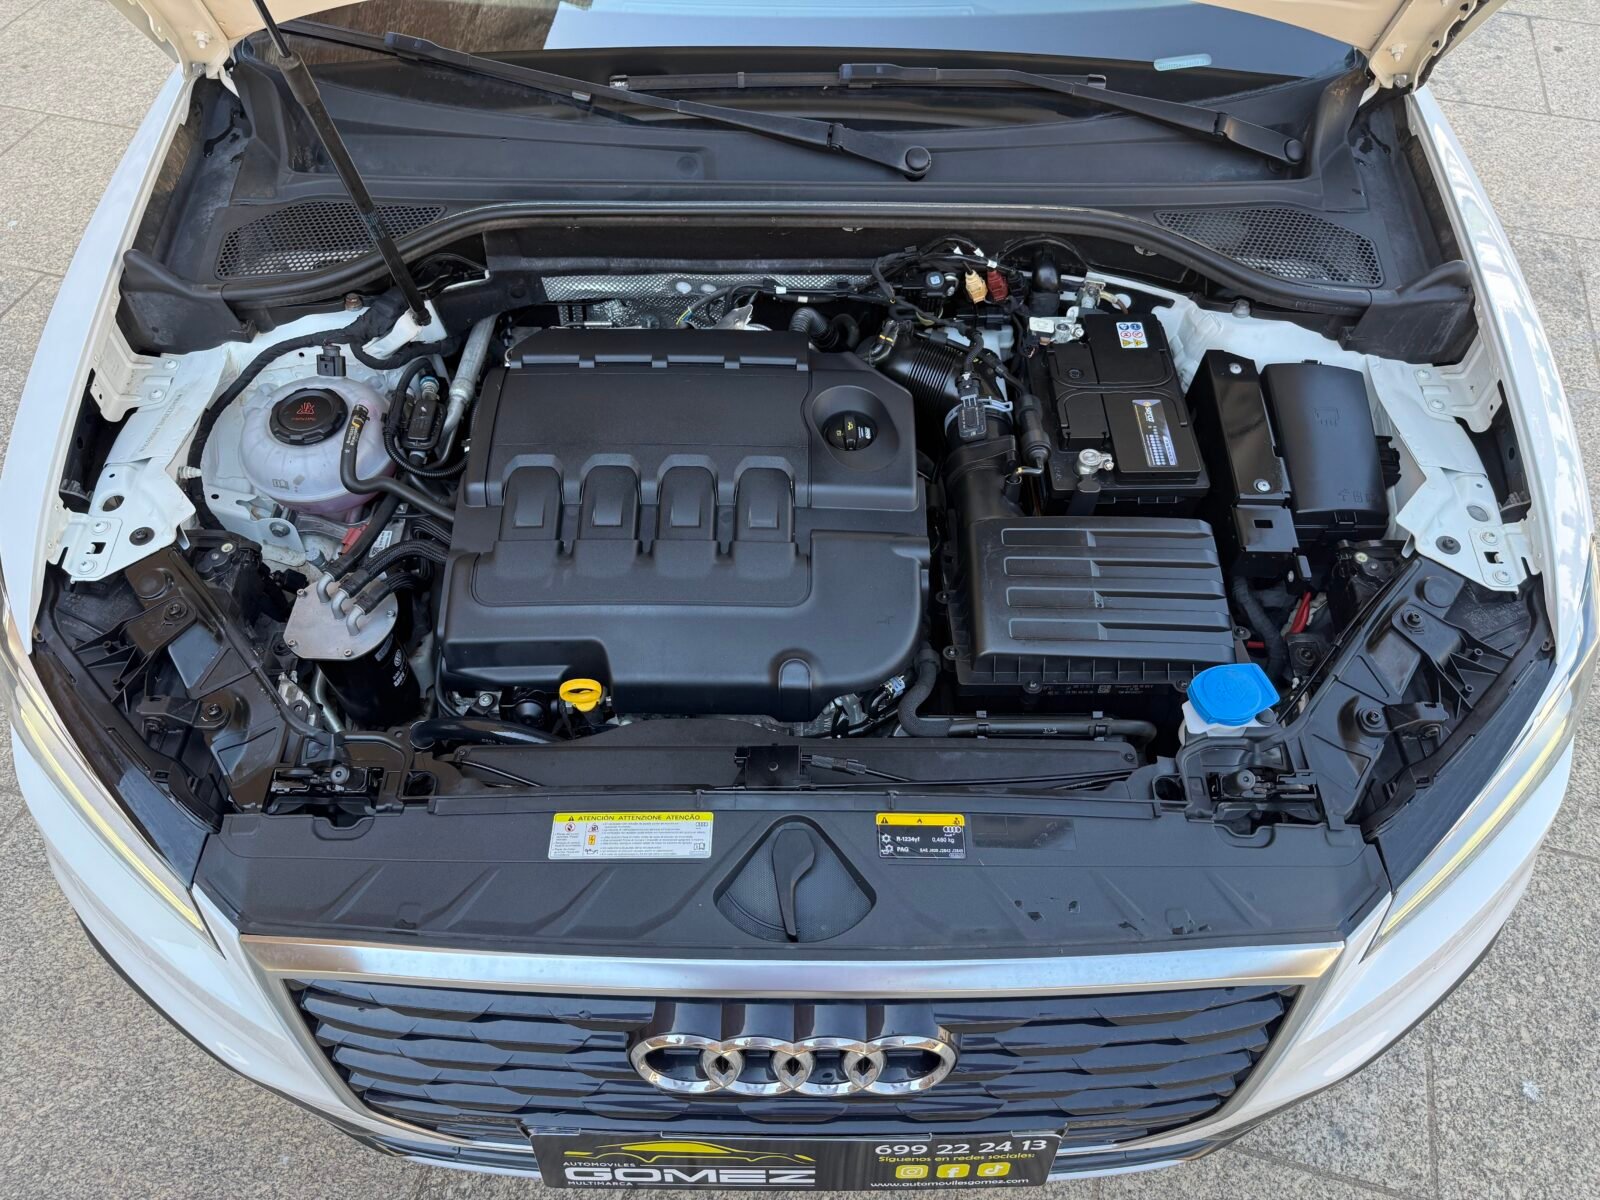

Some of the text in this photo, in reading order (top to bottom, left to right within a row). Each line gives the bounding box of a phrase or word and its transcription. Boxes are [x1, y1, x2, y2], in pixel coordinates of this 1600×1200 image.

[875, 1139, 1048, 1155] 699 22 24 13
[988, 1152, 1035, 1160] sociales:
[564, 1167, 816, 1183] GOMEZ
[870, 1178, 1030, 1188] www.automovilesgomez.com
